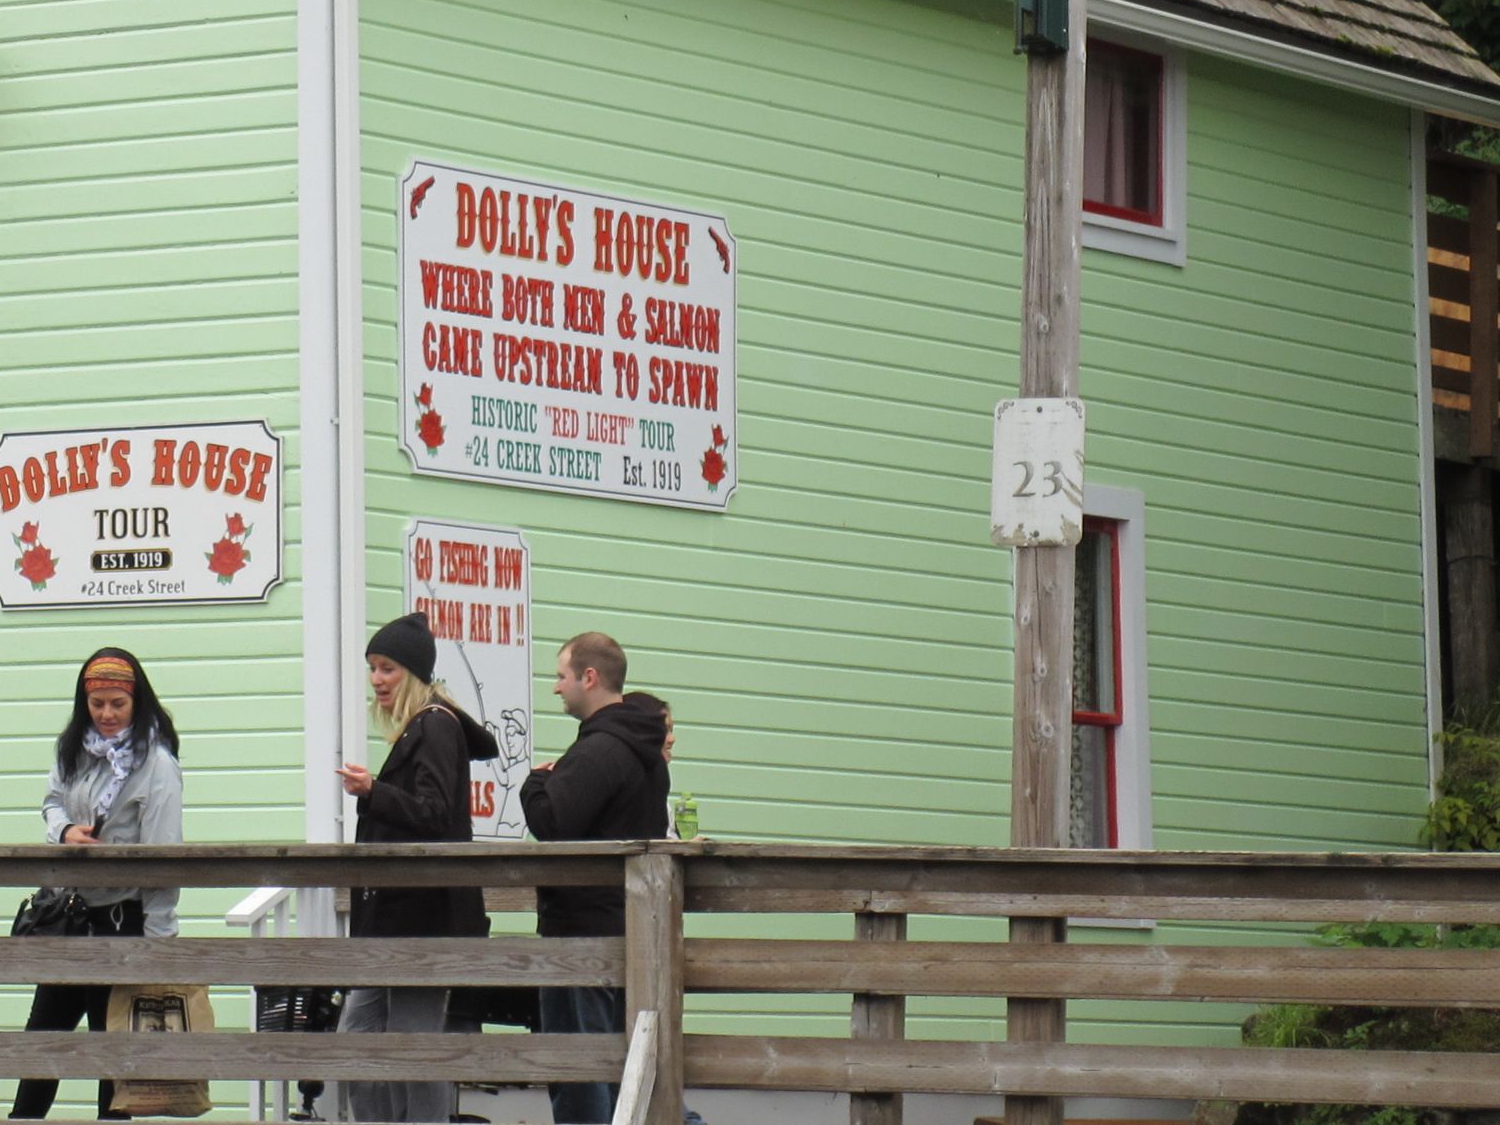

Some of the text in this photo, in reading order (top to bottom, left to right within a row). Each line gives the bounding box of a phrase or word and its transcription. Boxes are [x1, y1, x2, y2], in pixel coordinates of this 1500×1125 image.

[455, 182, 690, 285] DOLLY'S HOUSE
[419, 260, 720, 354] WHERE BOTH MEN & SALMON
[422, 321, 719, 412] CAME UPSTREAM TO SPAWN
[471, 395, 538, 434] HISTORIC
[639, 419, 676, 452] TOUR
[151, 439, 273, 503] HOUSE
[465, 435, 602, 482] #24 CREEK STREET
[623, 457, 682, 491] Est. 1919
[1012, 461, 1063, 499] 23
[94, 507, 171, 540] TOUR
[100, 552, 164, 569] EST. 1919
[415, 537, 523, 591] GO FISHING NOW
[81, 579, 186, 596] #24 Creek Street
[470, 603, 492, 643] ARE
[497, 605, 511, 645] IN
